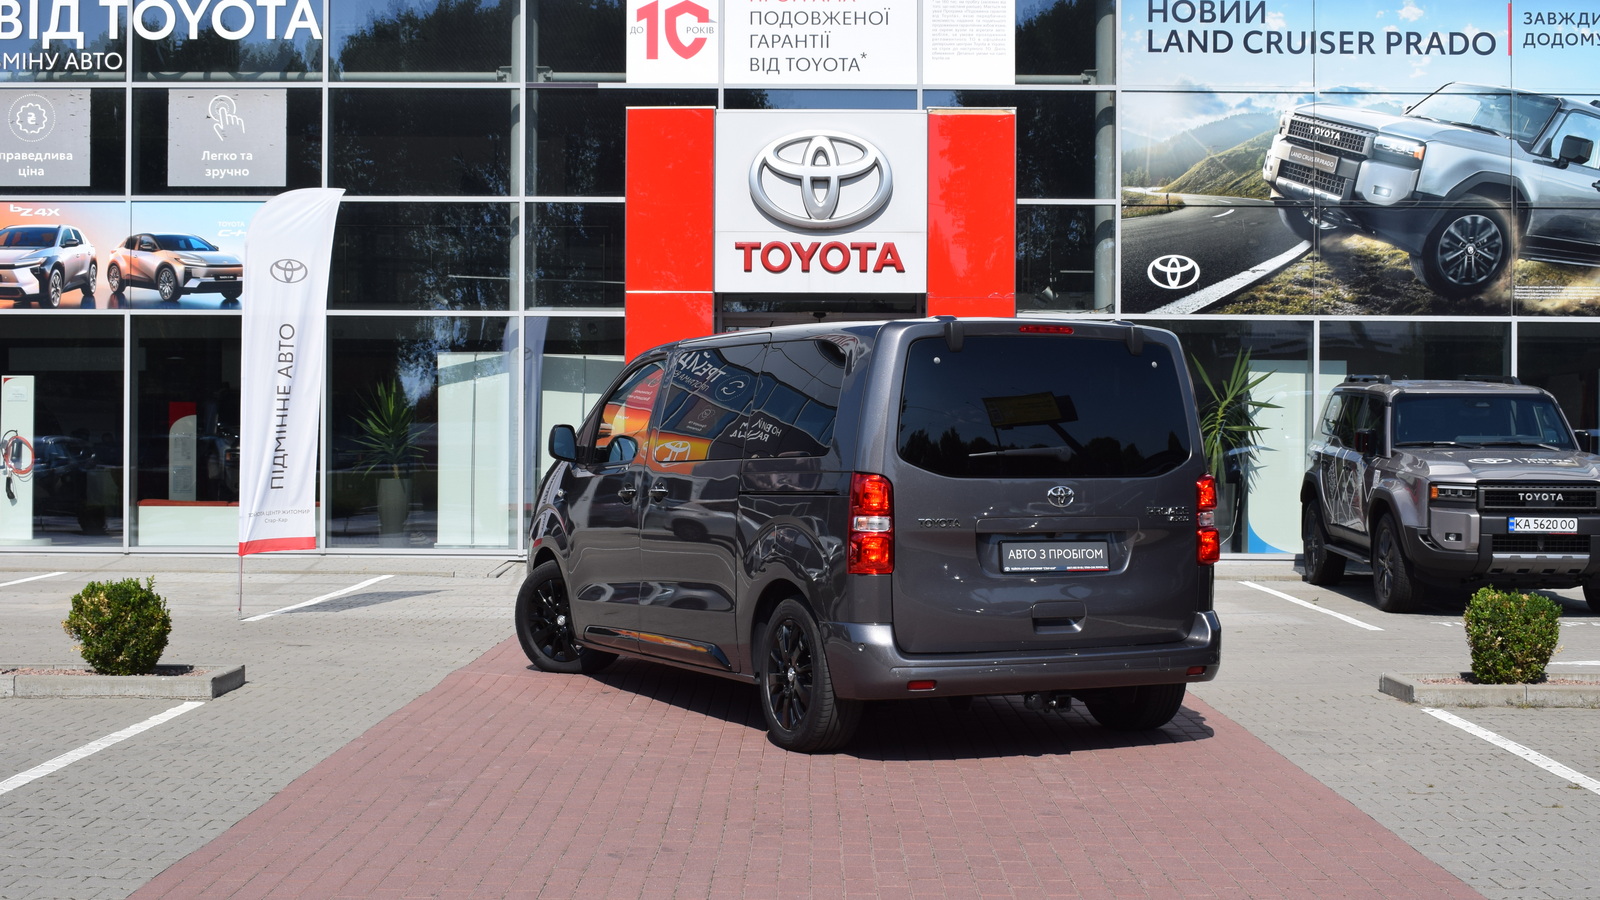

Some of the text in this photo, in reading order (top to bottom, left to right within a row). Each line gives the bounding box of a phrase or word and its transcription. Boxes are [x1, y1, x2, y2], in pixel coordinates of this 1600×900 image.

[0, 0, 322, 49] ВІД TOYOTA
[750, 8, 890, 28] ПОДОВЖЕНОЇ
[629, 0, 715, 60] ДО 10 РОКІВ
[750, 31, 830, 49] ГАРАНТІЇ
[1148, 30, 1496, 55] LAND CRUISER PRADO
[1523, 32, 1600, 49] ДОДОМ
[0, 52, 123, 70] МІНУ АВТО
[750, 57, 780, 75] ВІД
[1310, 126, 1340, 140] TOYOTA
[201, 151, 253, 161] Легко та
[18, 166, 45, 179] ціна
[205, 168, 250, 179] зручно
[735, 241, 905, 274] TOYOTA
[270, 323, 295, 489] ПІДМІННЕ АВТО
[1518, 492, 1564, 501] TOYOTA
[918, 518, 961, 528] TOYOTA
[1515, 519, 1531, 530] KA
[1533, 519, 1558, 530] 5620
[1008, 548, 1037, 560] АВТО
[1048, 548, 1104, 560] ПРОБІГОМ
